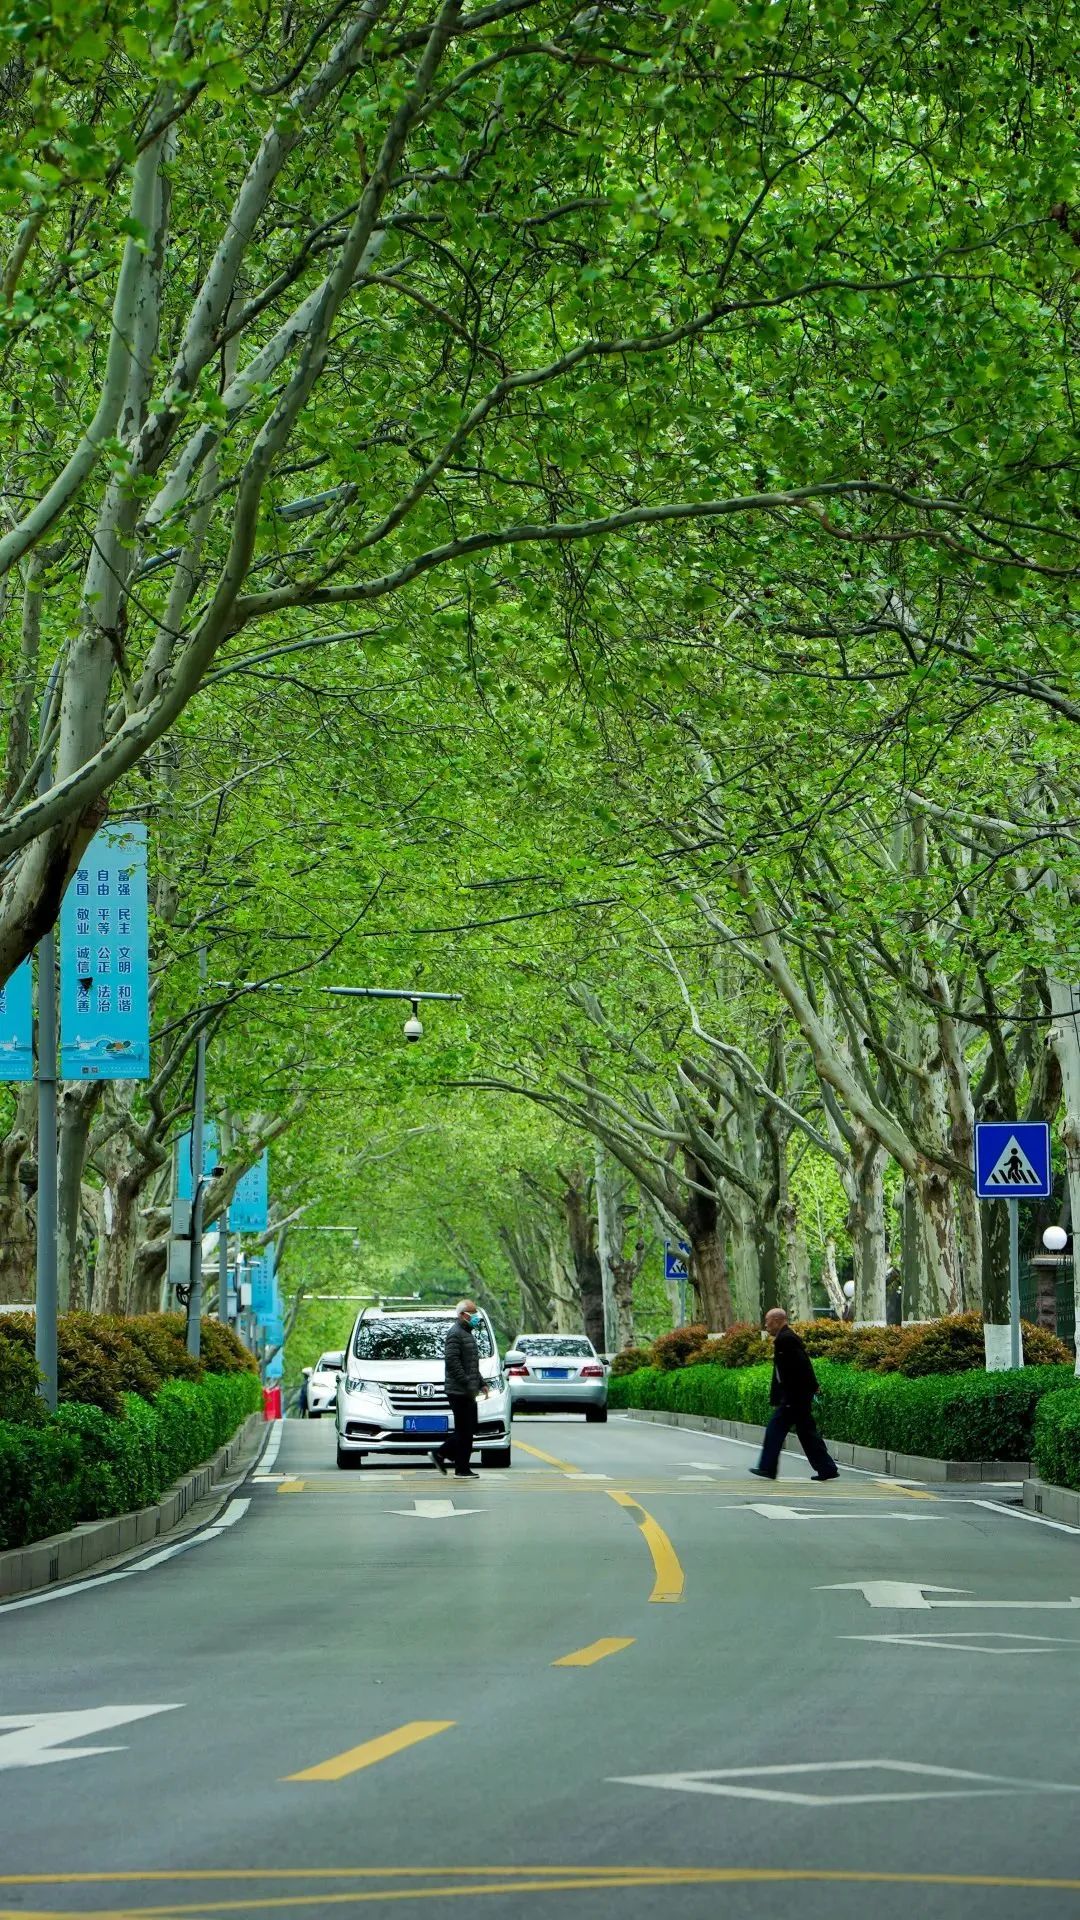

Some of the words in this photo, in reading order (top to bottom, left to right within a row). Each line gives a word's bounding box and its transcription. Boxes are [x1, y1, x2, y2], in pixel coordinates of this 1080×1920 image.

[77, 869, 89, 896] 爱国
[98, 869, 109, 896] 自由
[117, 869, 131, 896] 富强
[77, 908, 90, 935] 敬业
[98, 908, 110, 935] 平等
[118, 908, 131, 935] 民主
[77, 946, 90, 974] 诚信
[98, 946, 111, 973] 公正
[118, 946, 131, 973] 文明
[98, 985, 111, 1012] 法治
[118, 985, 131, 1012] 和谐
